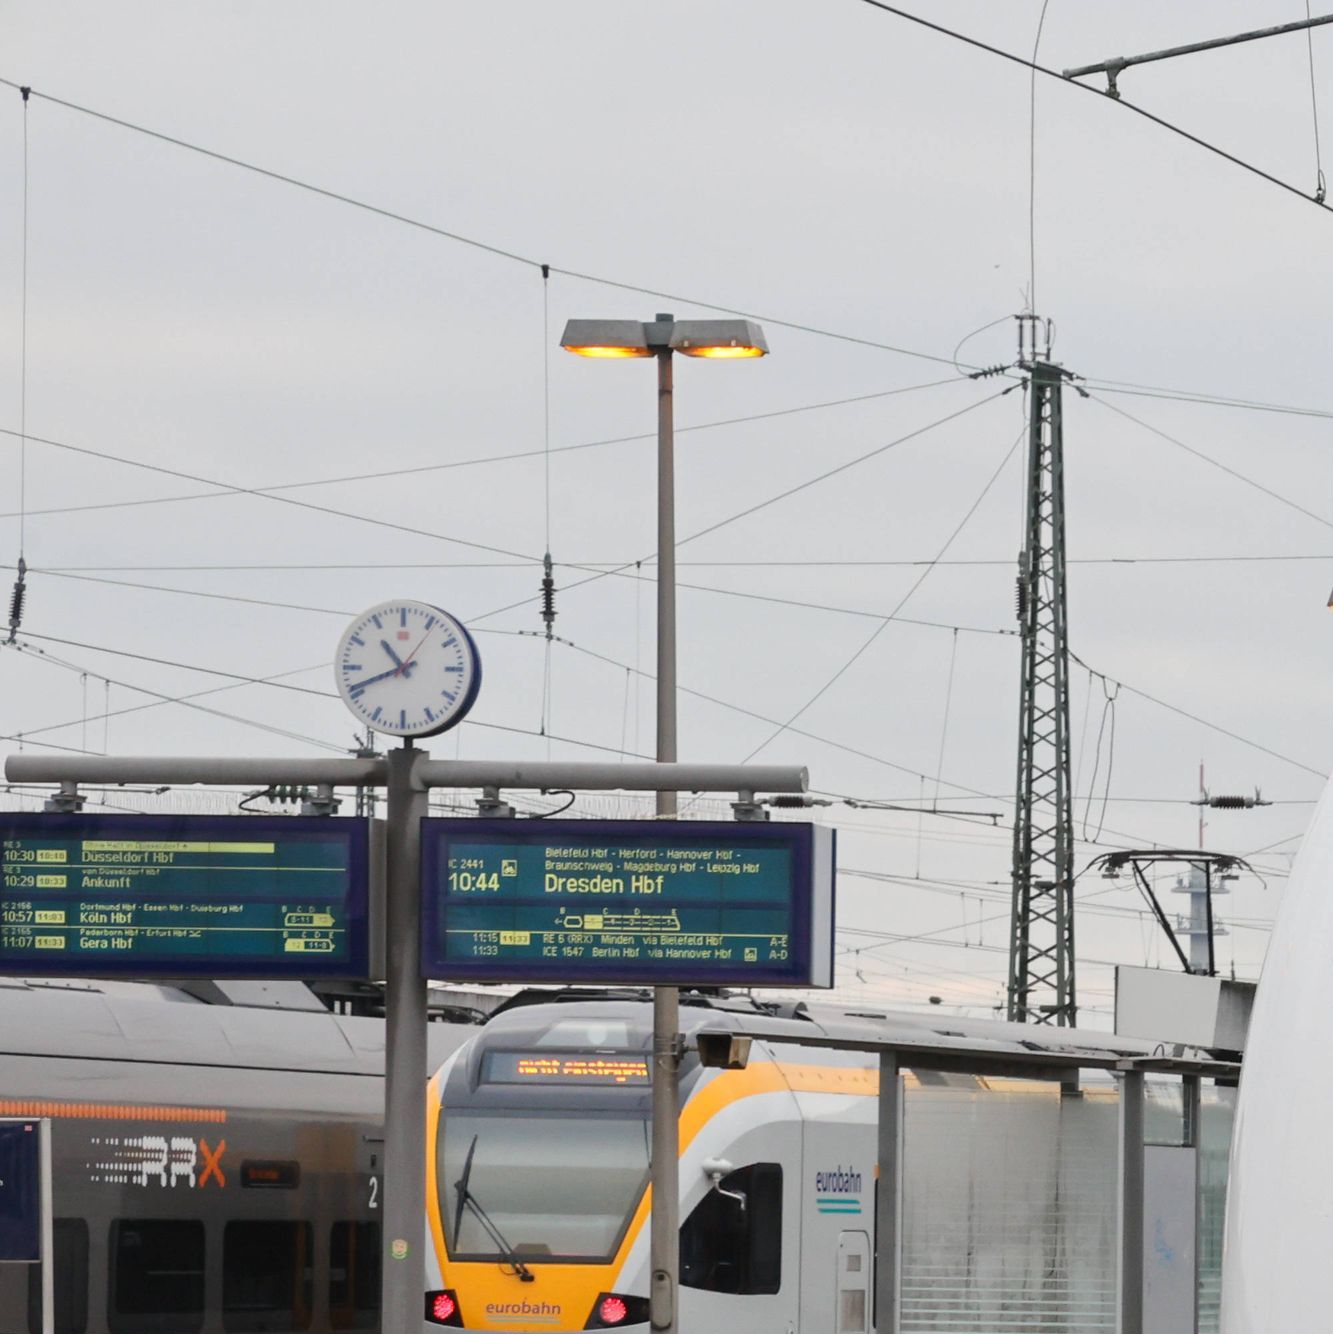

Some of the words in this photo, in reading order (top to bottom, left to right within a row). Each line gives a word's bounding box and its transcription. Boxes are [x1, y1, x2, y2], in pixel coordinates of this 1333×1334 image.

[4, 850, 35, 861] 10:30
[152, 852, 174, 863] Hbf
[545, 847, 589, 858] Bielefeld
[591, 848, 608, 858] Hbf
[618, 849, 657, 860] Herford
[666, 849, 713, 860] Hannover
[715, 850, 734, 861] Hbf
[448, 859, 458, 869] IC
[460, 859, 484, 869] 2441
[545, 860, 614, 873] Braunschweig
[623, 862, 677, 874] Magdeburg
[679, 862, 696, 873] Hbf
[706, 863, 740, 875] Leipzig
[742, 863, 760, 874] Hbf
[4, 875, 34, 887] 10:29
[81, 876, 131, 888] Ankunft
[448, 873, 500, 892] 10:44
[544, 873, 624, 894] Dresden
[631, 875, 665, 894] Hbf
[79, 902, 121, 912] Dortmund
[121, 903, 137, 912] Hbf
[143, 903, 167, 912] Essen
[190, 904, 228, 915] Duisburg
[2, 911, 33, 924] 10:57
[79, 910, 108, 924] Köln
[110, 911, 133, 924] Hbf
[79, 927, 124, 937] Paderborn
[145, 928, 171, 938] Erfurt
[2, 936, 33, 948] 11:07
[79, 937, 108, 949] Gera
[111, 937, 133, 949] Hbf
[472, 933, 499, 944] 11:15
[502, 935, 529, 945] 11:33
[542, 934, 555, 945] RE
[557, 934, 564, 944] 6
[567, 934, 594, 945] (RRX)
[600, 935, 635, 945] Minden
[642, 936, 657, 945] via
[660, 935, 703, 946] Bielefeld
[705, 936, 724, 946] Hbf
[769, 937, 788, 948] A-E
[472, 946, 499, 957] 11:33
[542, 946, 558, 957] ICE
[592, 947, 621, 958] Berlin
[622, 947, 640, 958] Hbf
[648, 948, 663, 959] via
[665, 948, 712, 960] Hannover
[713, 948, 732, 960] Hbf
[768, 949, 789, 960] A-D
[816, 1164, 862, 1193] eurobahn
[368, 1176, 379, 1209] 2
[486, 1300, 561, 1315] eurobahn
